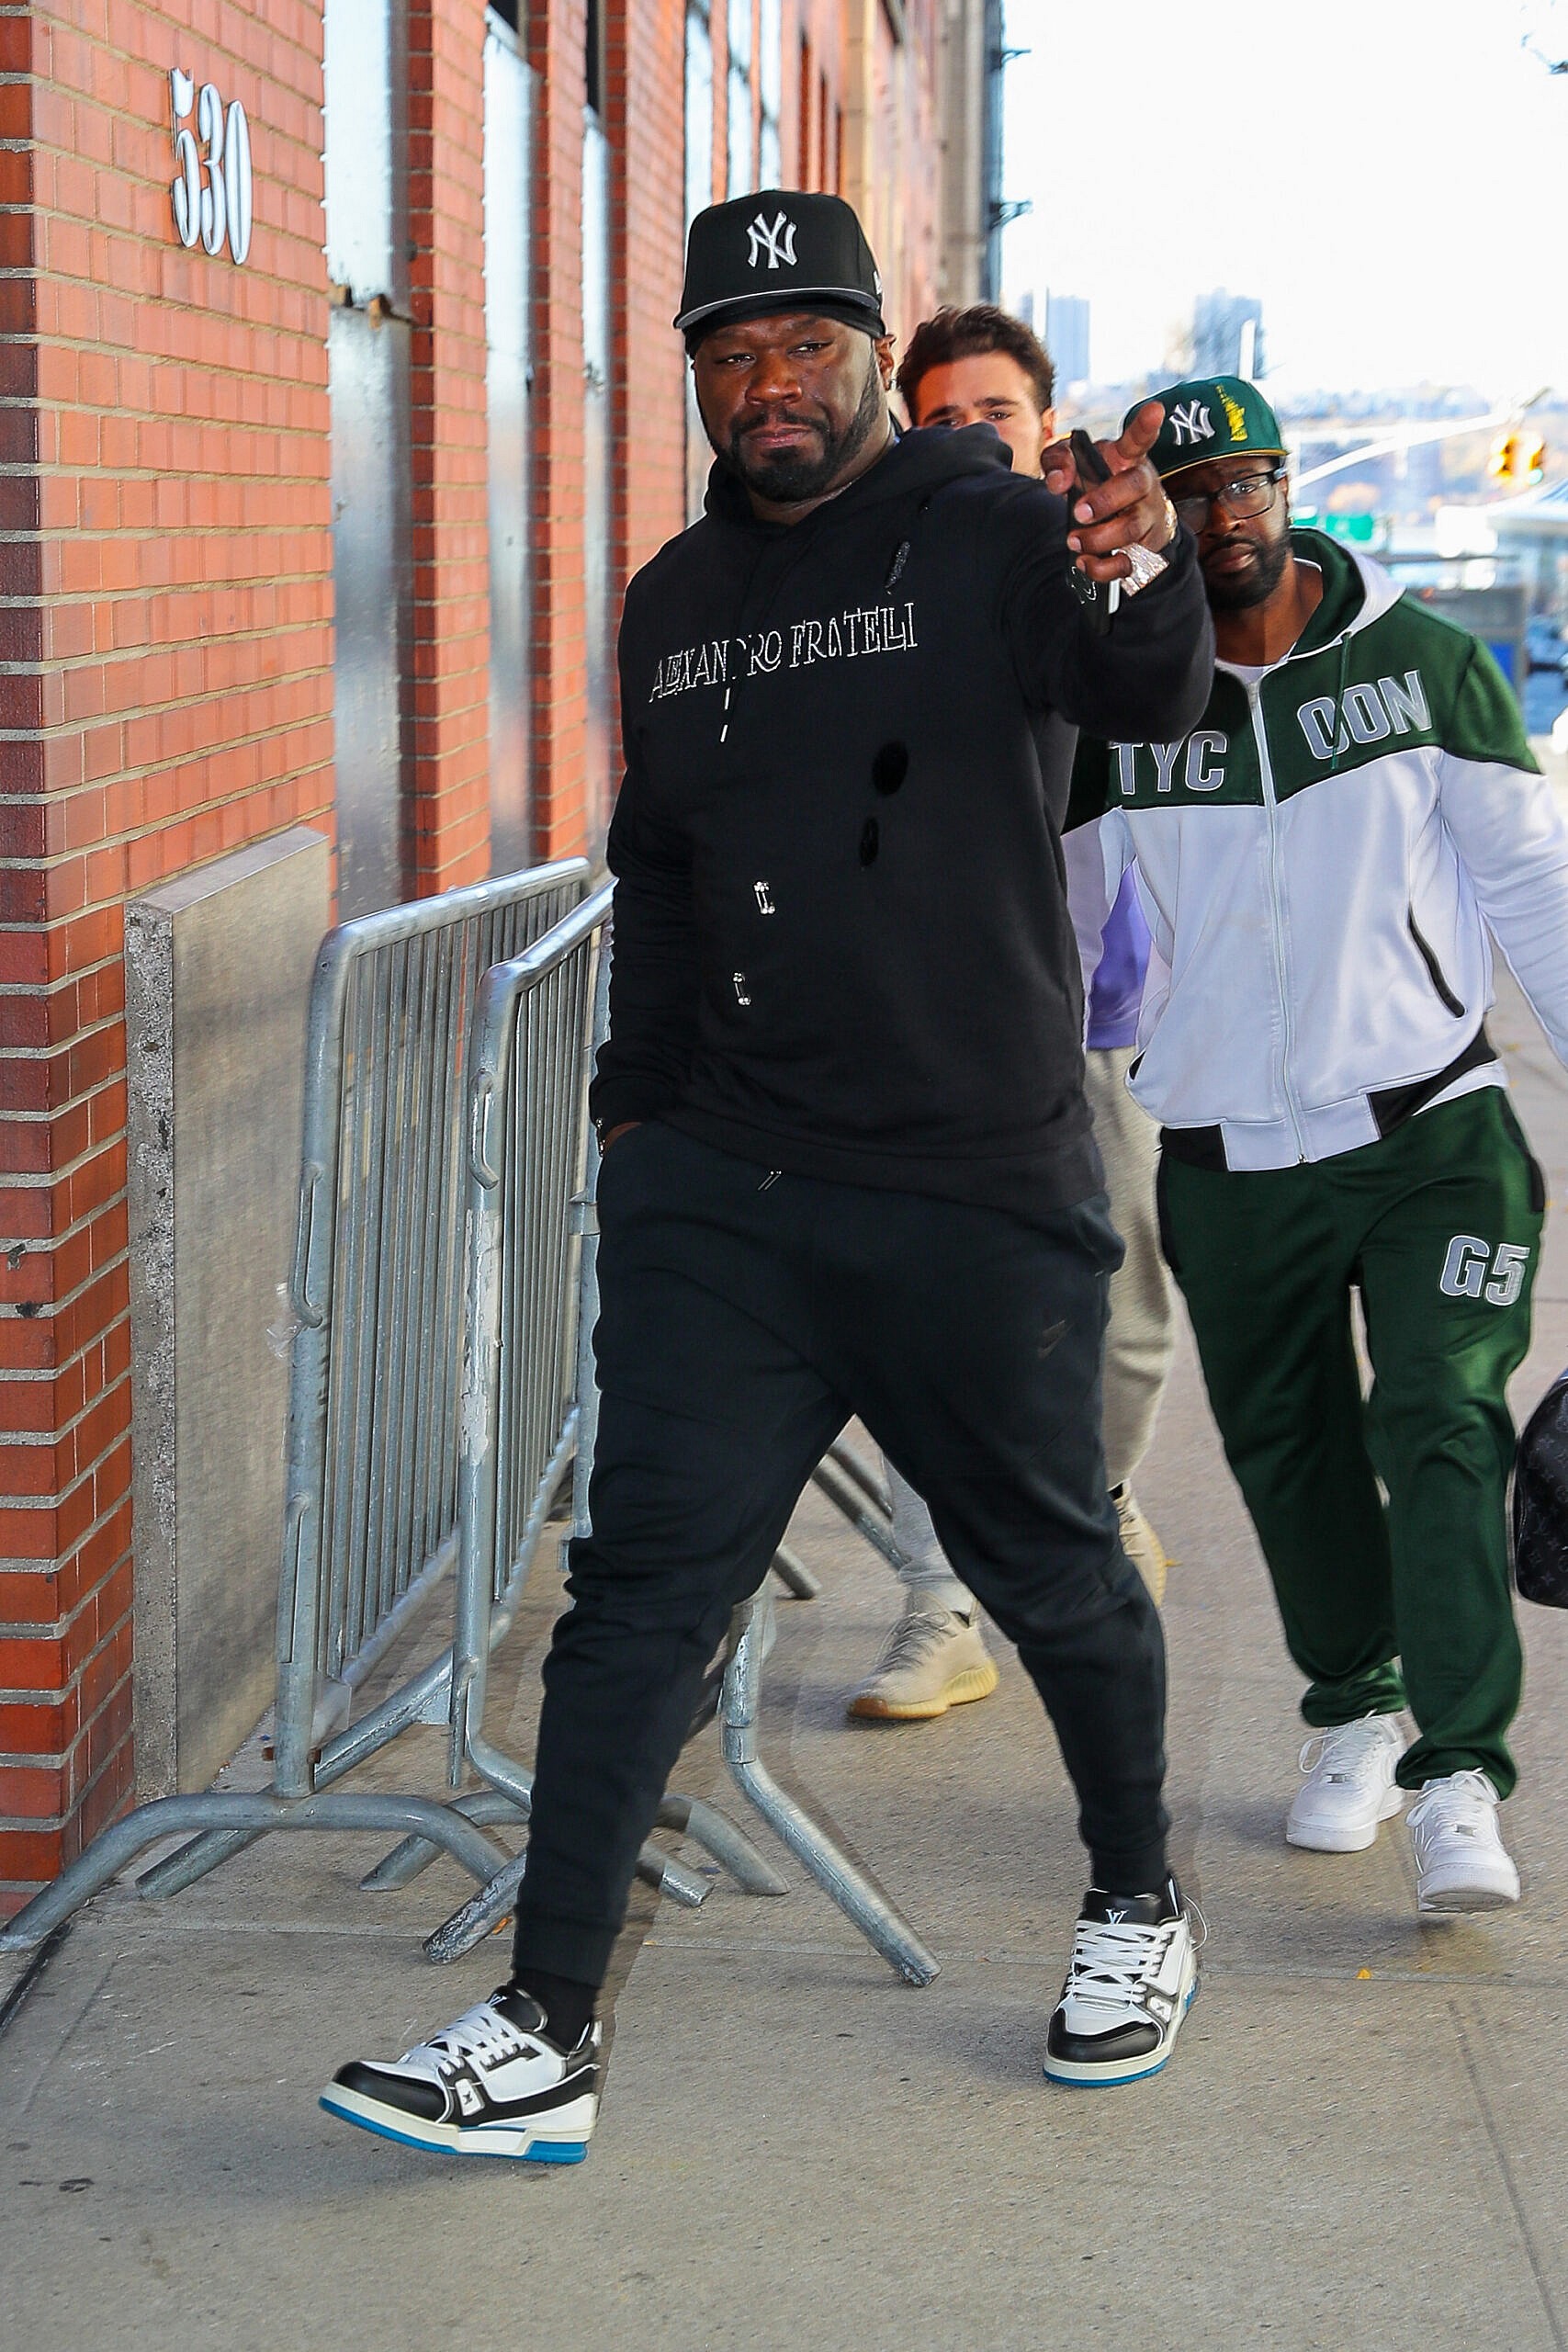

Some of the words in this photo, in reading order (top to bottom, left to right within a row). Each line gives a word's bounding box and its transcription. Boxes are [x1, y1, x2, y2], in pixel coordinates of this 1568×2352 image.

[169, 66, 253, 265] 530
[746, 209, 798, 269] NY
[1169, 399, 1216, 446] NY
[1440, 1234, 1531, 1306] G5
